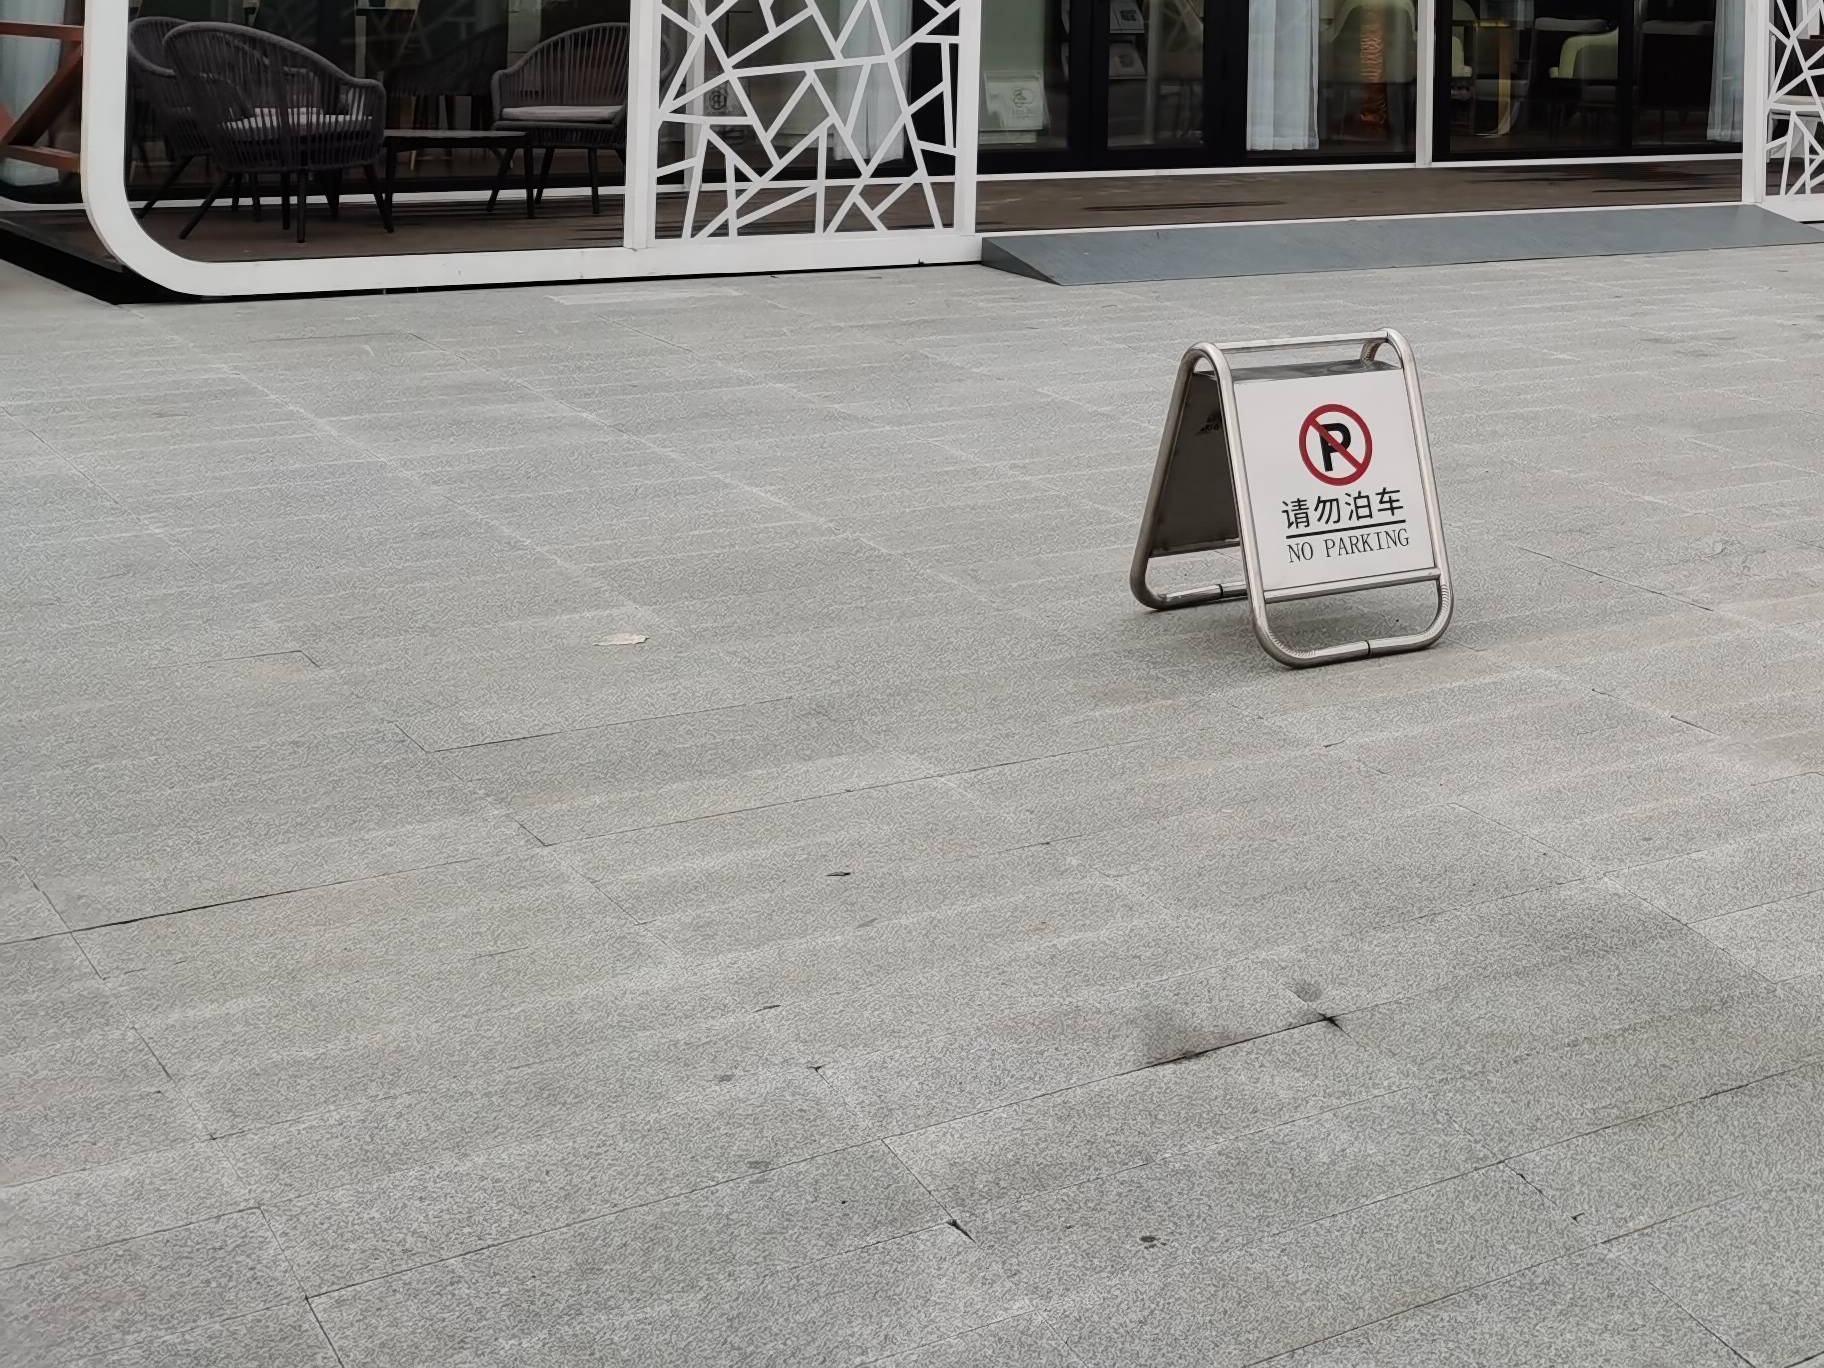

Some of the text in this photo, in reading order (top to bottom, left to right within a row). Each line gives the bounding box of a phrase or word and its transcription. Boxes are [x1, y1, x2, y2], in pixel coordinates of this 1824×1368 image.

[1281, 486, 1404, 531] 请勿泊车
[1287, 527, 1410, 564] NO PARKING
